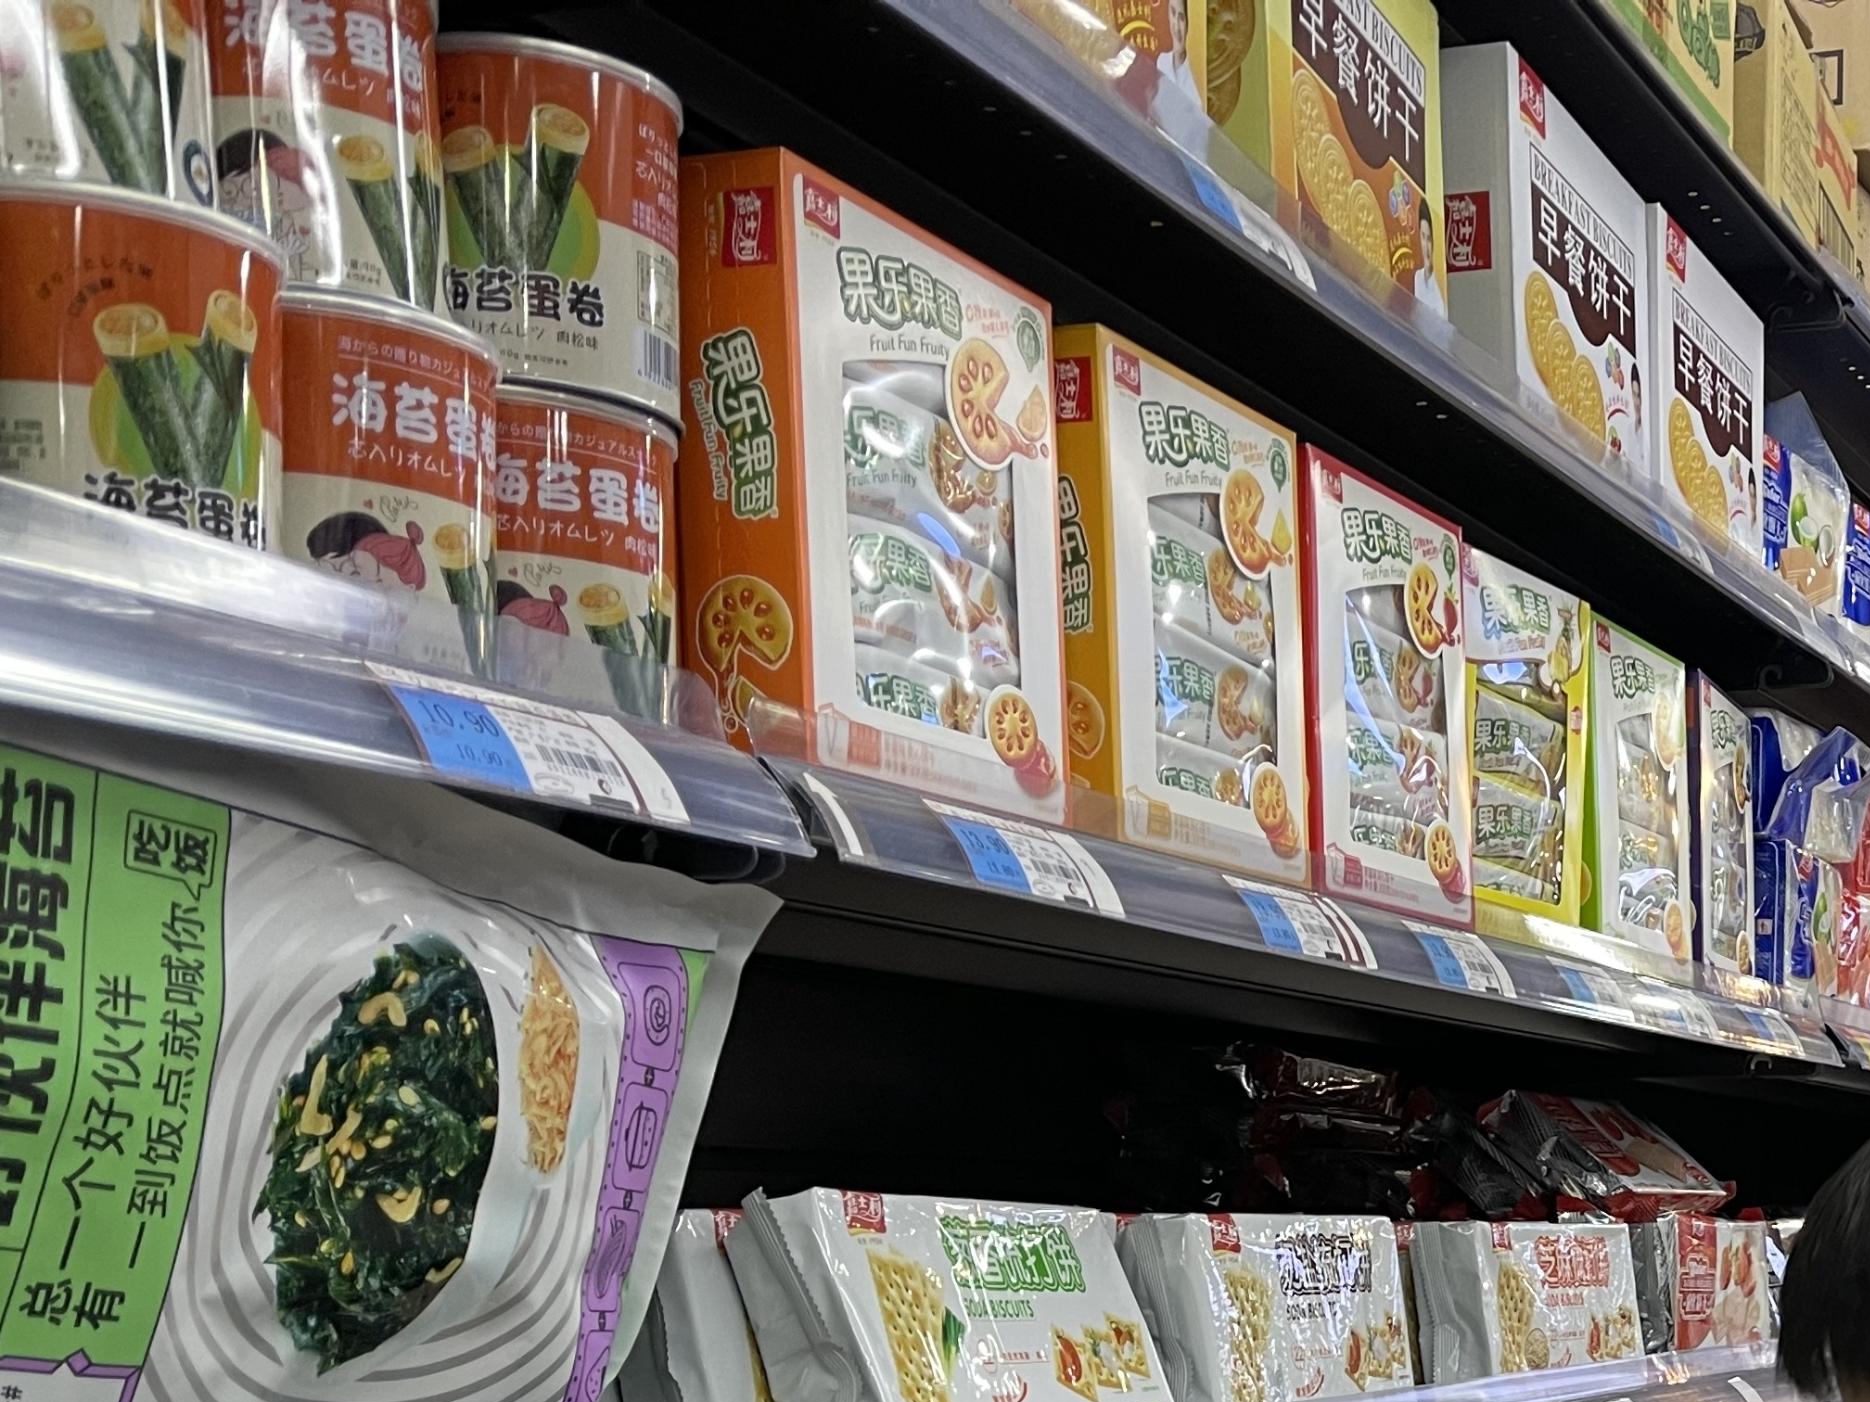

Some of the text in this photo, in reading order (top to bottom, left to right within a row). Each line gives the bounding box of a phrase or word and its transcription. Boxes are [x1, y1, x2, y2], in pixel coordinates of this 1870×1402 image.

[1300, 0, 1420, 163] 早餐饼干
[1372, 17, 1424, 98] BISCUITS
[1446, 194, 1477, 268] 嘉士利
[1533, 158, 1634, 279] BREAKFAST BISCUITS
[836, 246, 963, 341] 果乐果香
[1537, 196, 1631, 335] 早餐饼干
[870, 335, 950, 359] Fruit Fun Fruity
[1675, 300, 1752, 389] BREAKFAST BISCUITS
[702, 331, 777, 519] 果乐果香
[1678, 332, 1749, 444] 早餐饼干
[690, 380, 728, 500] Fruit Fun Fruity
[1139, 401, 1231, 472] 果乐果香
[1166, 471, 1184, 487] Fruit
[1185, 471, 1199, 486] Fun
[1341, 507, 1413, 566] 果乐果香
[1480, 583, 1551, 640] 果乐果香
[418, 700, 500, 738] 10.90
[457, 743, 503, 767] 10.90
[132, 818, 210, 877] 吃饭
[59, 973, 148, 1271] 一个好伙伴
[127, 900, 207, 1270] 一到饭点就喊你
[19, 1278, 126, 1331] 总有
[991, 1300, 1035, 1318] BISCUITS
